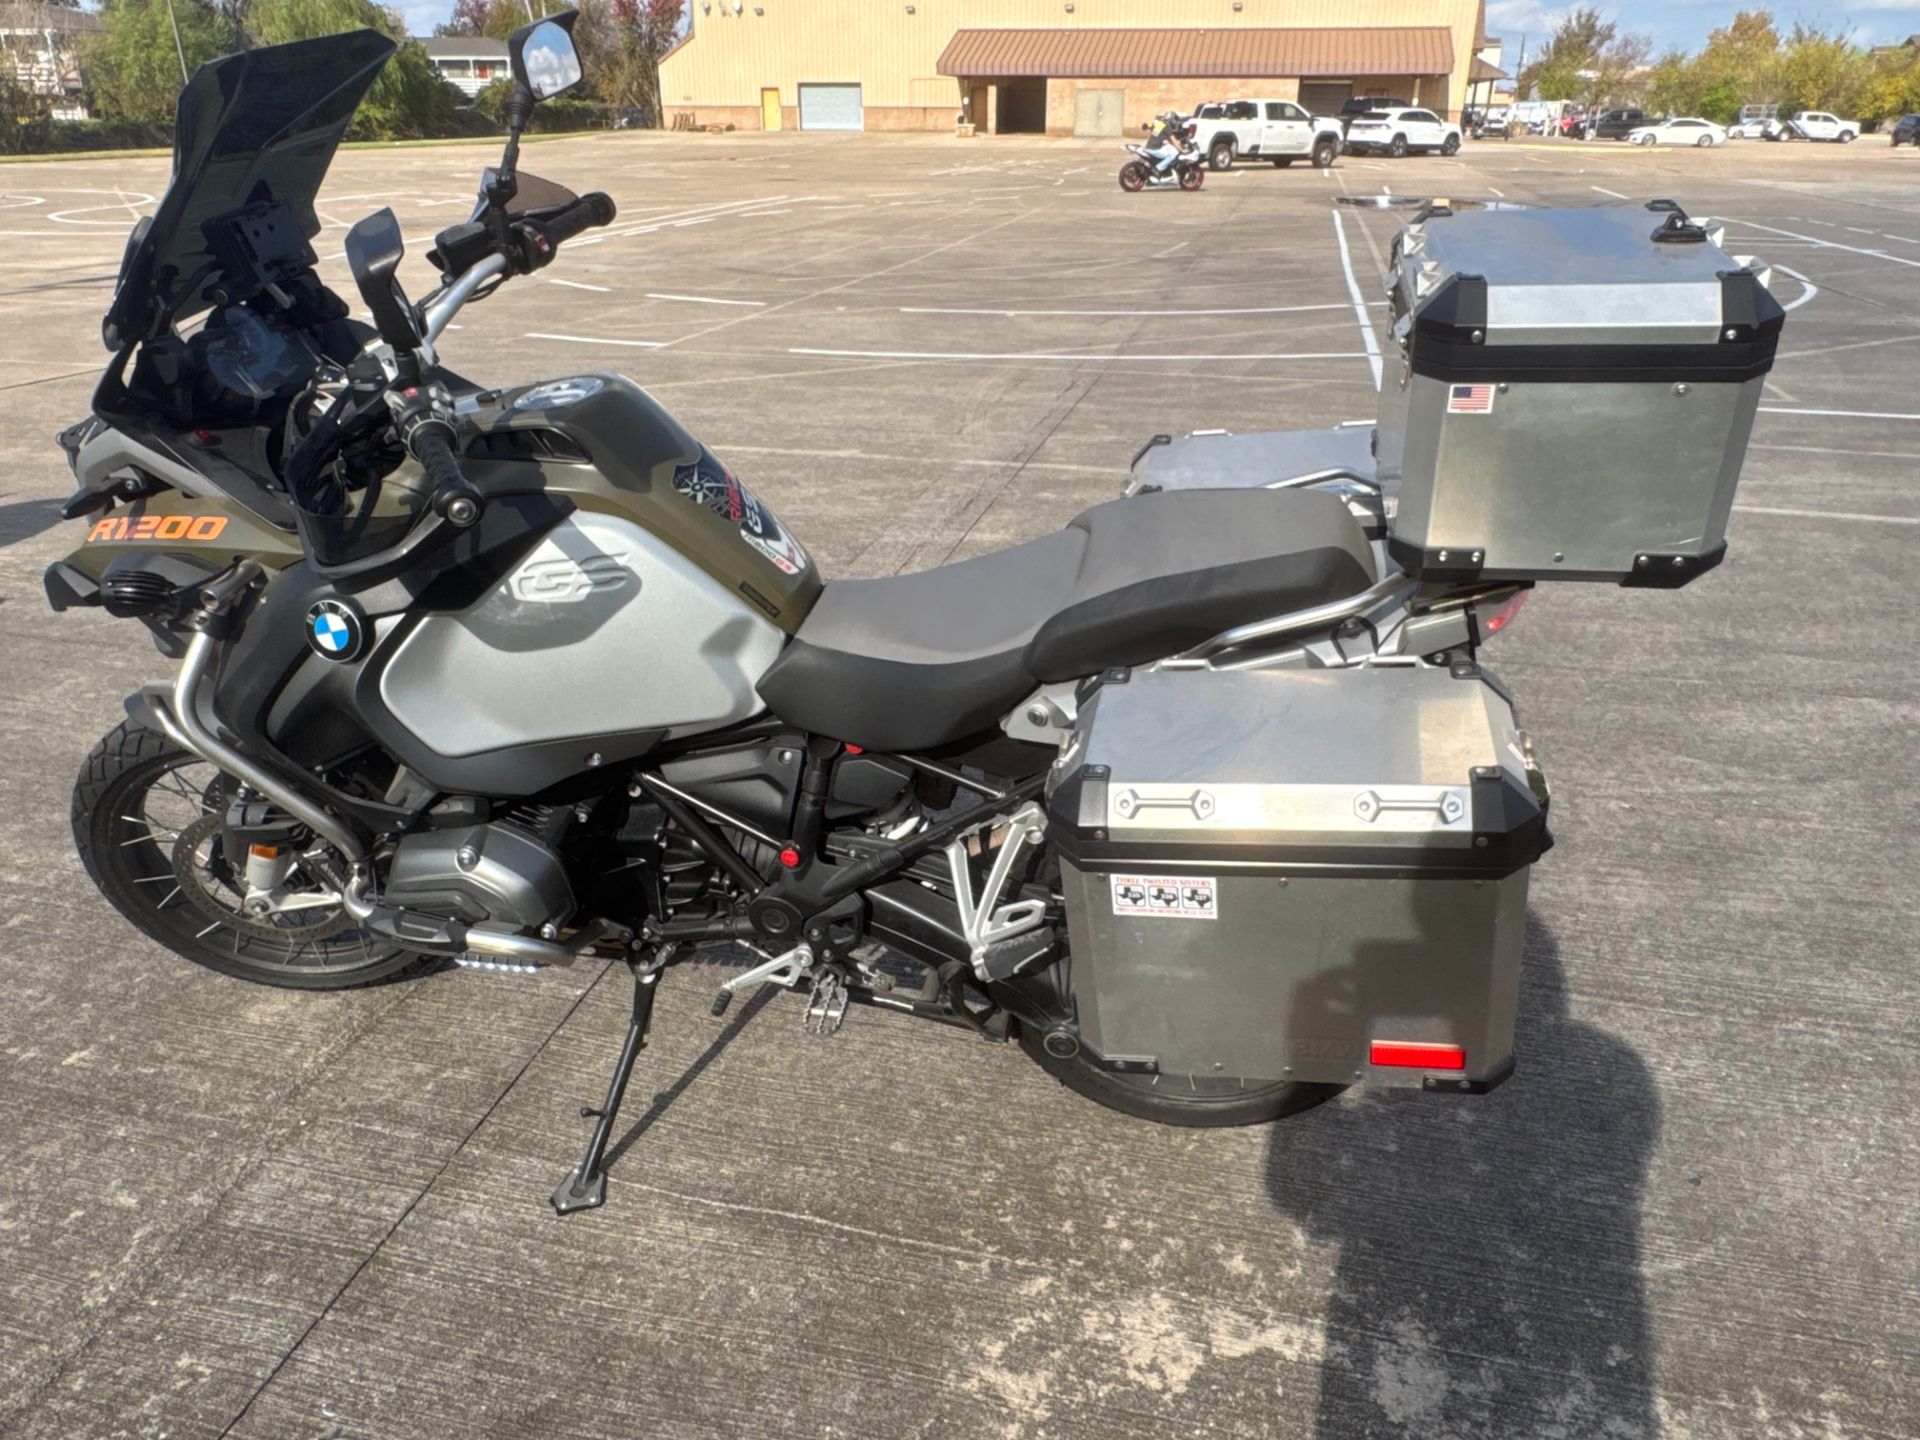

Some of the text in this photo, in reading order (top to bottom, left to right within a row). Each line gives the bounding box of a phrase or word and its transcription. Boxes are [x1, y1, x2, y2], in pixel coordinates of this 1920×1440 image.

[87, 515, 229, 543] R1200
[517, 552, 630, 597] GS
[306, 601, 350, 625] BMW
